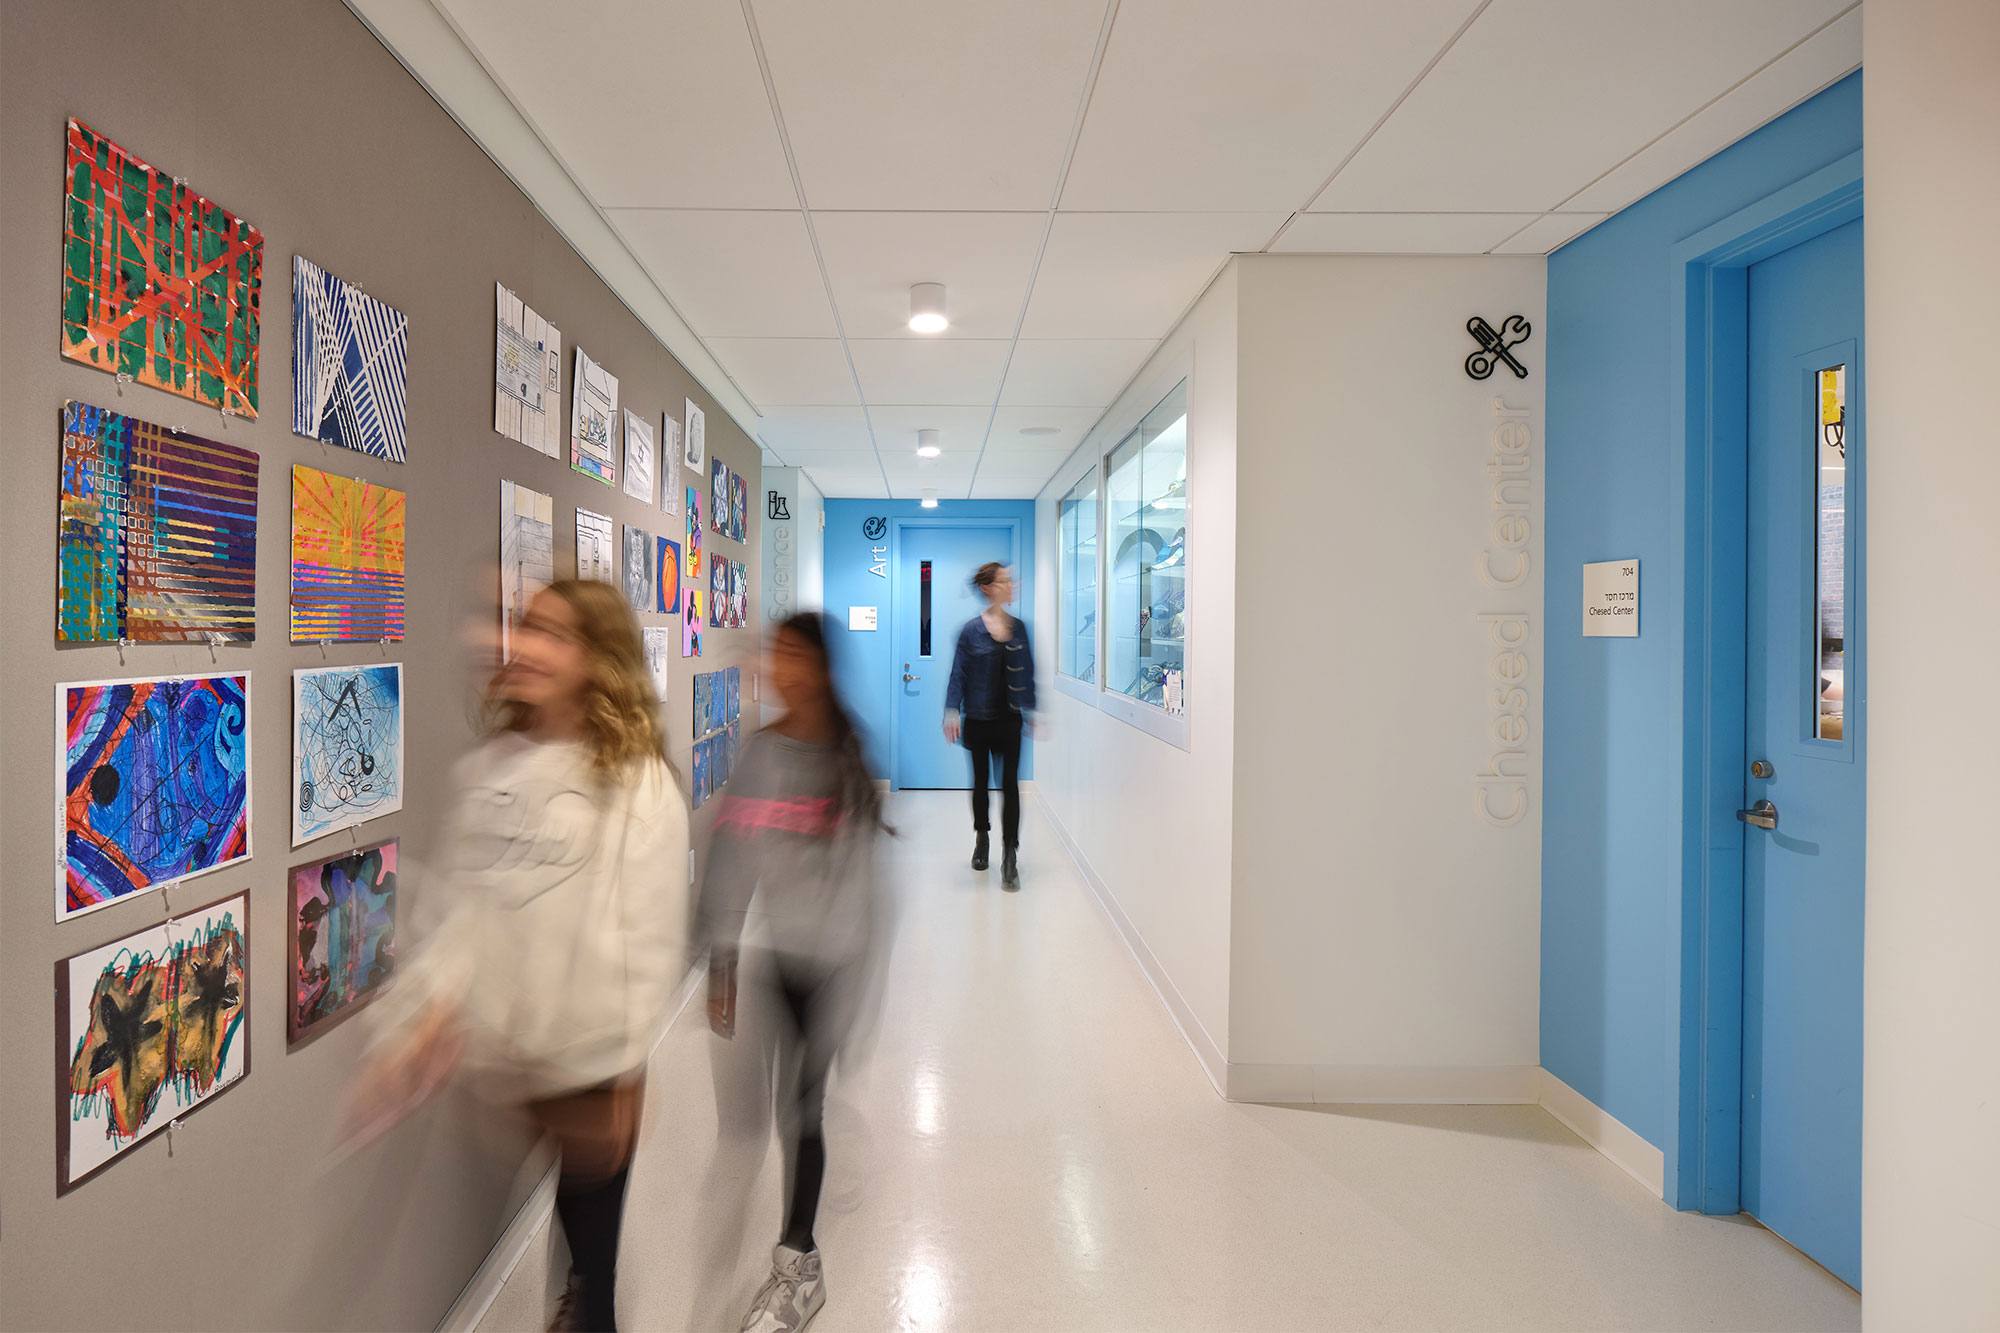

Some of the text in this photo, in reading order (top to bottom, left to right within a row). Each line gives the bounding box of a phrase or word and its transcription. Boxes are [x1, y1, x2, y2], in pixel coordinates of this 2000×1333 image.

[868, 545, 887, 579] Art
[1622, 567, 1634, 576] 704
[768, 526, 789, 621] Science
[1605, 592, 1634, 601] מרכז חסד
[1474, 396, 1531, 828] Chesed Center
[1588, 606, 1634, 616] Chesed Center
